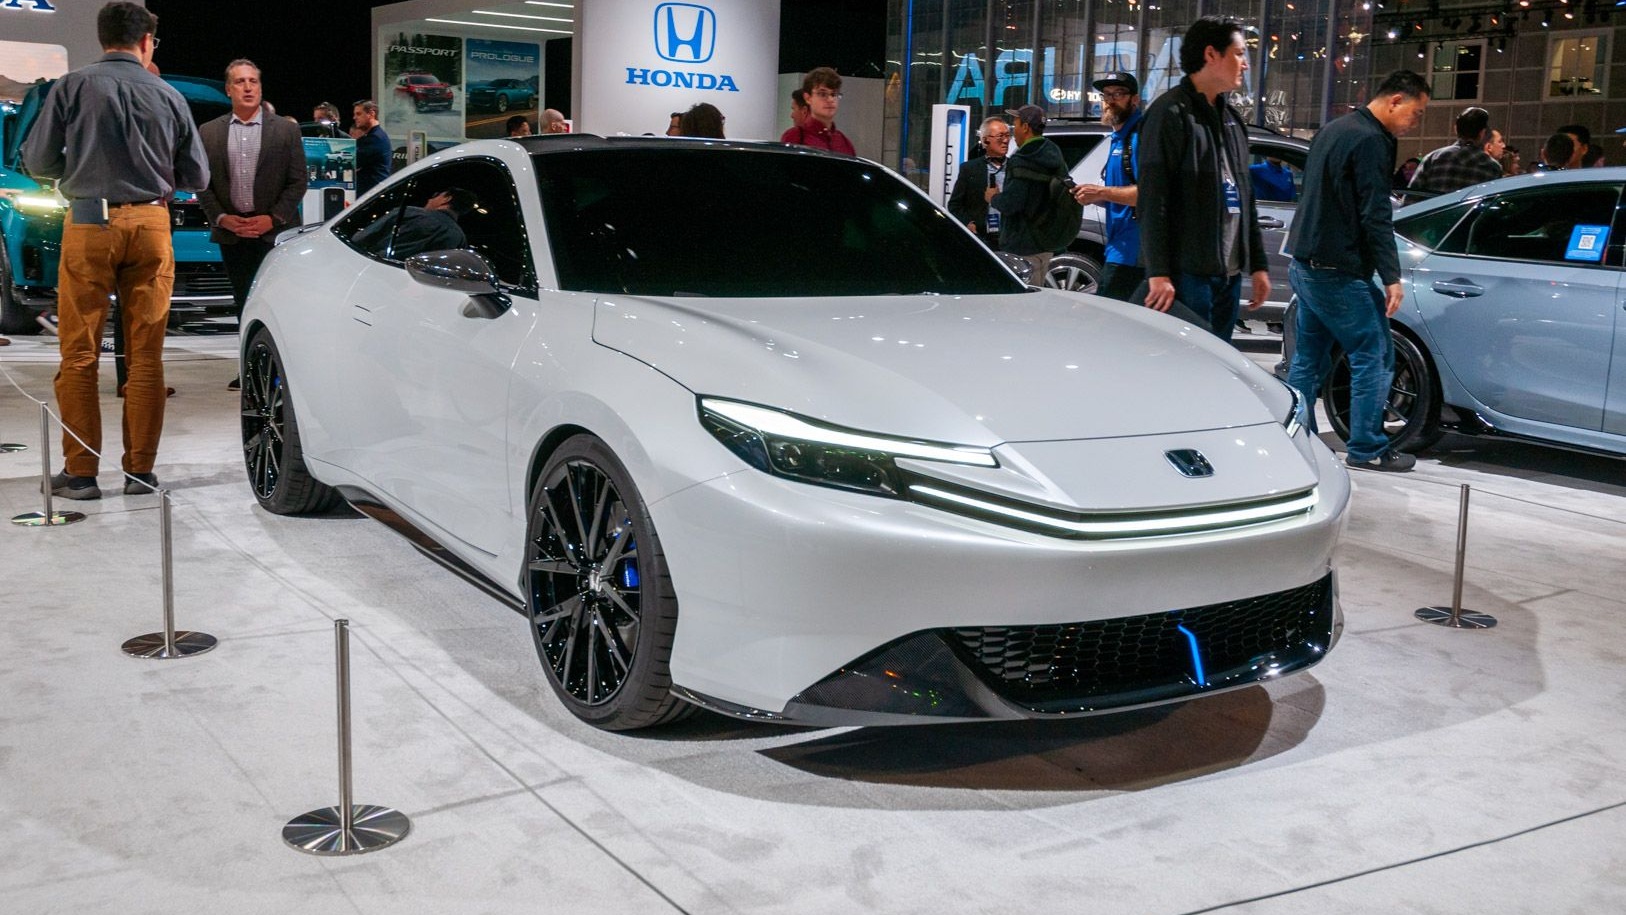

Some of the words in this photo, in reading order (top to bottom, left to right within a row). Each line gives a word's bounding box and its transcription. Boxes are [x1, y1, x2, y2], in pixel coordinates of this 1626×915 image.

[389, 45, 458, 57] PASSPORT
[471, 51, 534, 63] PROLOGUE
[626, 67, 740, 92] HONDA
[945, 144, 953, 195] PILOT
